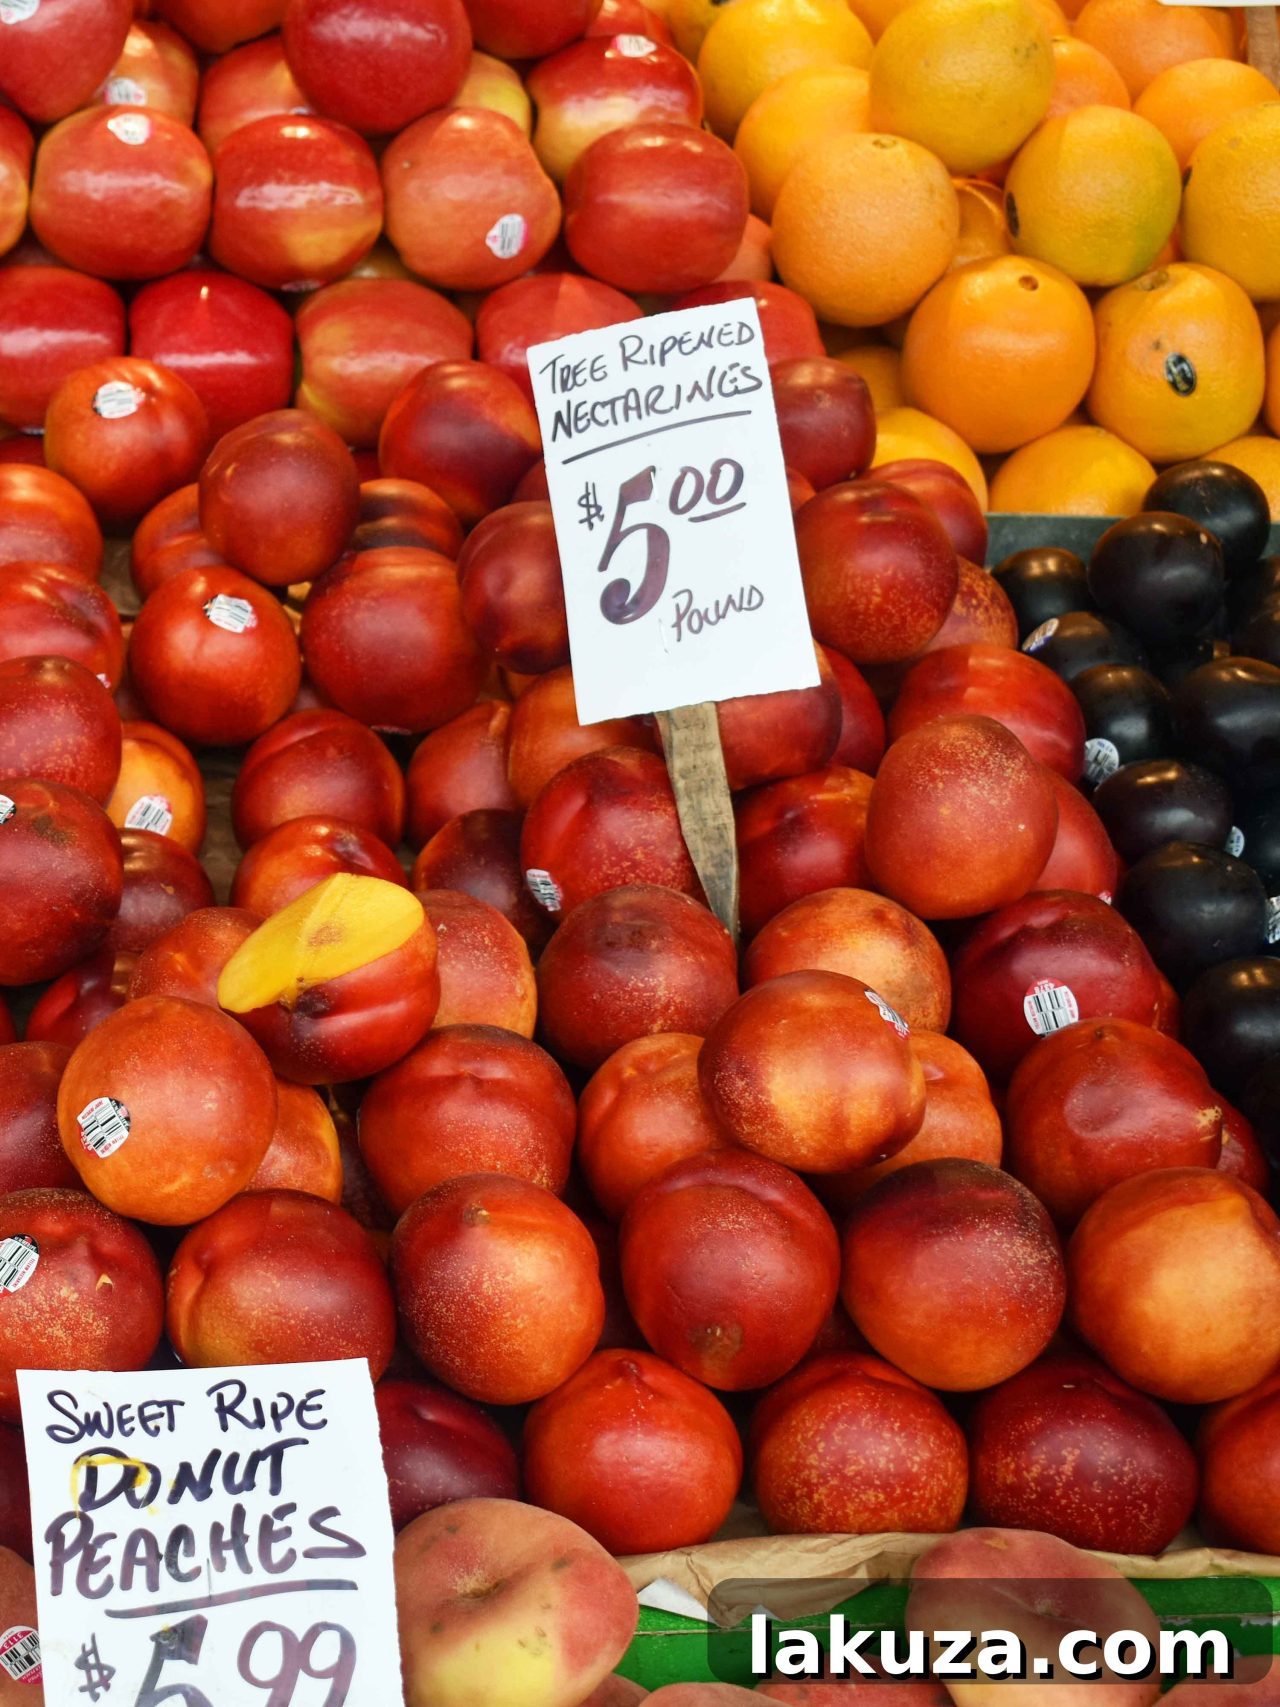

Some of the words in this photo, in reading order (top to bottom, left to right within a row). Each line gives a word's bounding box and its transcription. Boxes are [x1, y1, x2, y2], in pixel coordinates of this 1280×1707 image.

[539, 354, 608, 394] TREE
[619, 321, 755, 372] RIPENED
[45, 1389, 185, 1444] SWEET
[205, 1378, 328, 1434] RIPE
[74, 1437, 310, 1513] DONUT
[44, 1502, 367, 1600] PEACHES
[3, 1632, 24, 1650] 3113
